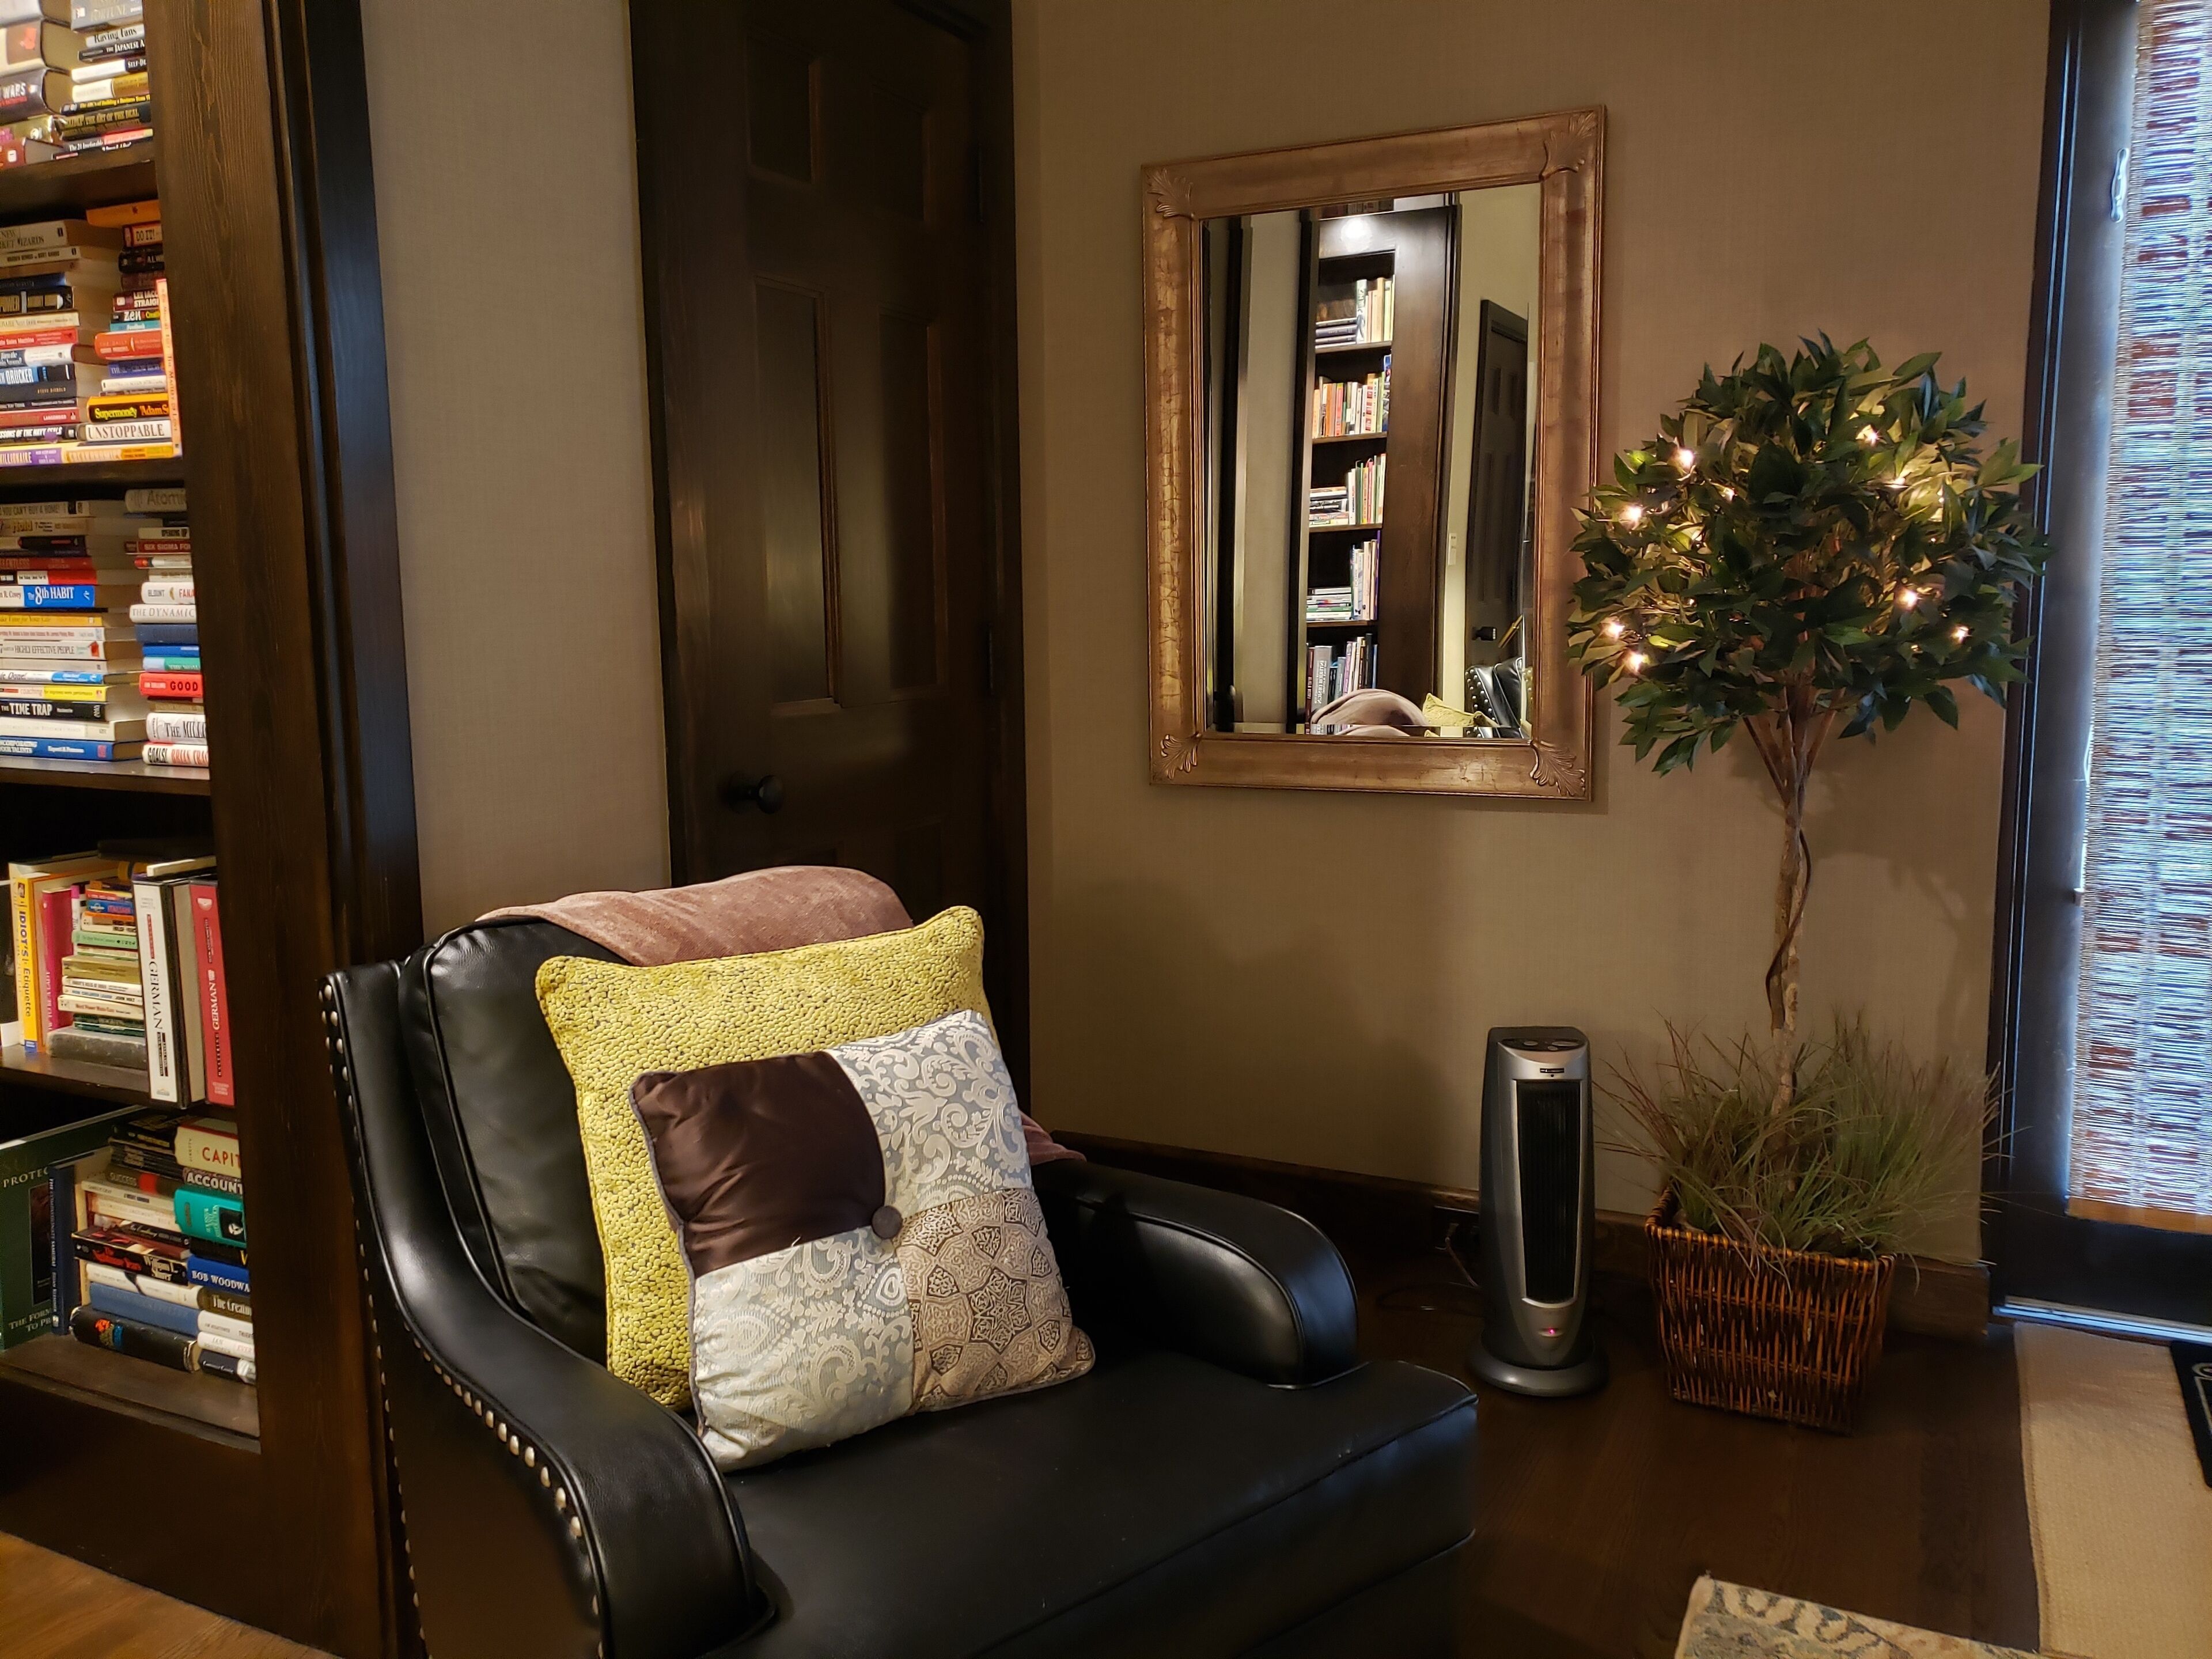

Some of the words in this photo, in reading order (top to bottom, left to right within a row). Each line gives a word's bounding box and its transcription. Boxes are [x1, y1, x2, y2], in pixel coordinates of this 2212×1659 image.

[94, 31, 119, 43] Raving
[115, 41, 139, 53] JAPANESE
[136, 231, 144, 241] DO
[6, 368, 34, 385] DRUCKER
[88, 424, 164, 440] UNSTOPPABLE
[35, 586, 50, 605] 8th
[50, 586, 75, 599] HABIT
[133, 608, 146, 616] THE
[149, 607, 194, 618] DYNAMIC
[32, 645, 56, 654] EFFECTIVE
[58, 646, 75, 655] PEOPLE
[169, 681, 199, 692] GOOD
[9, 702, 31, 715] TIME
[31, 703, 52, 716] TRAP
[183, 721, 206, 738] MILLI
[148, 747, 168, 764] GOALS!
[18, 910, 29, 957] IDIOT'S
[22, 967, 32, 1018] Etiquette
[149, 960, 163, 1029] GERMAN
[210, 982, 220, 1031] GERMAN
[192, 1270, 209, 1282] BOB
[211, 1275, 251, 1293] WOODWA
